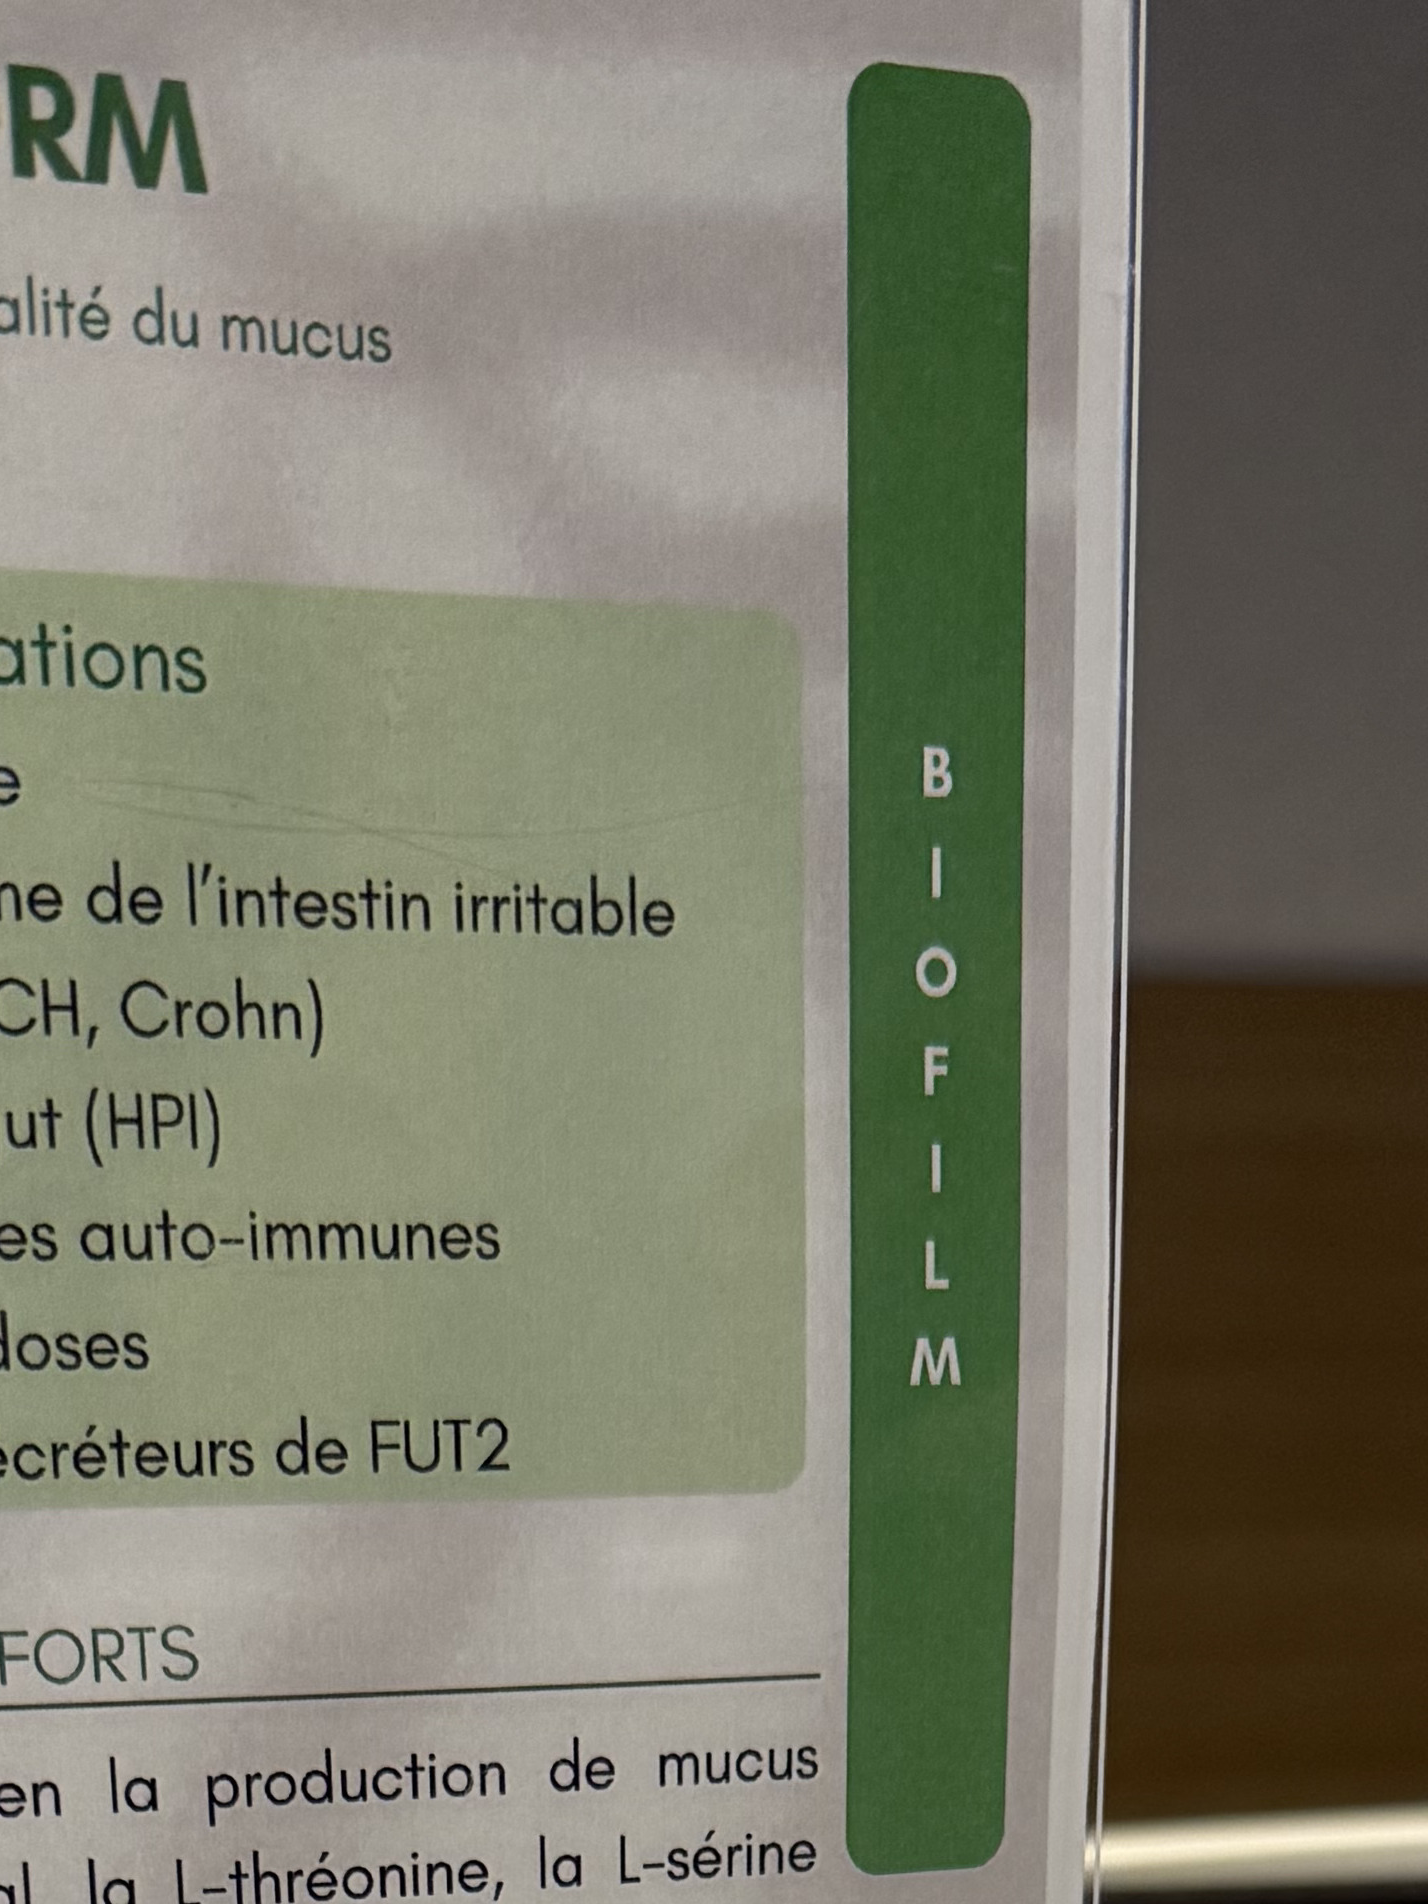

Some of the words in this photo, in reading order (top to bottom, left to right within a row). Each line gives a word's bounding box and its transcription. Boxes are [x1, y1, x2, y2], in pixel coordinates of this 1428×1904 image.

[132, 285, 199, 348] du
[222, 314, 392, 363] mucus
[87, 860, 163, 925] de
[188, 862, 431, 931] l'intestin
[455, 874, 675, 937] irritable
[120, 977, 323, 1058] Crohn)
[910, 745, 961, 1386] BIOFILM
[86, 1087, 219, 1168] (HPI)
[80, 1209, 500, 1261] auto-immunes
[276, 1415, 348, 1476] de
[371, 1417, 509, 1473] FUT2
[109, 1756, 158, 1813] la
[207, 1747, 506, 1827] production
[550, 1736, 615, 1792] de
[659, 1746, 818, 1787] mucus
[540, 1835, 581, 1889] la
[620, 1830, 816, 1884] L-sérine
